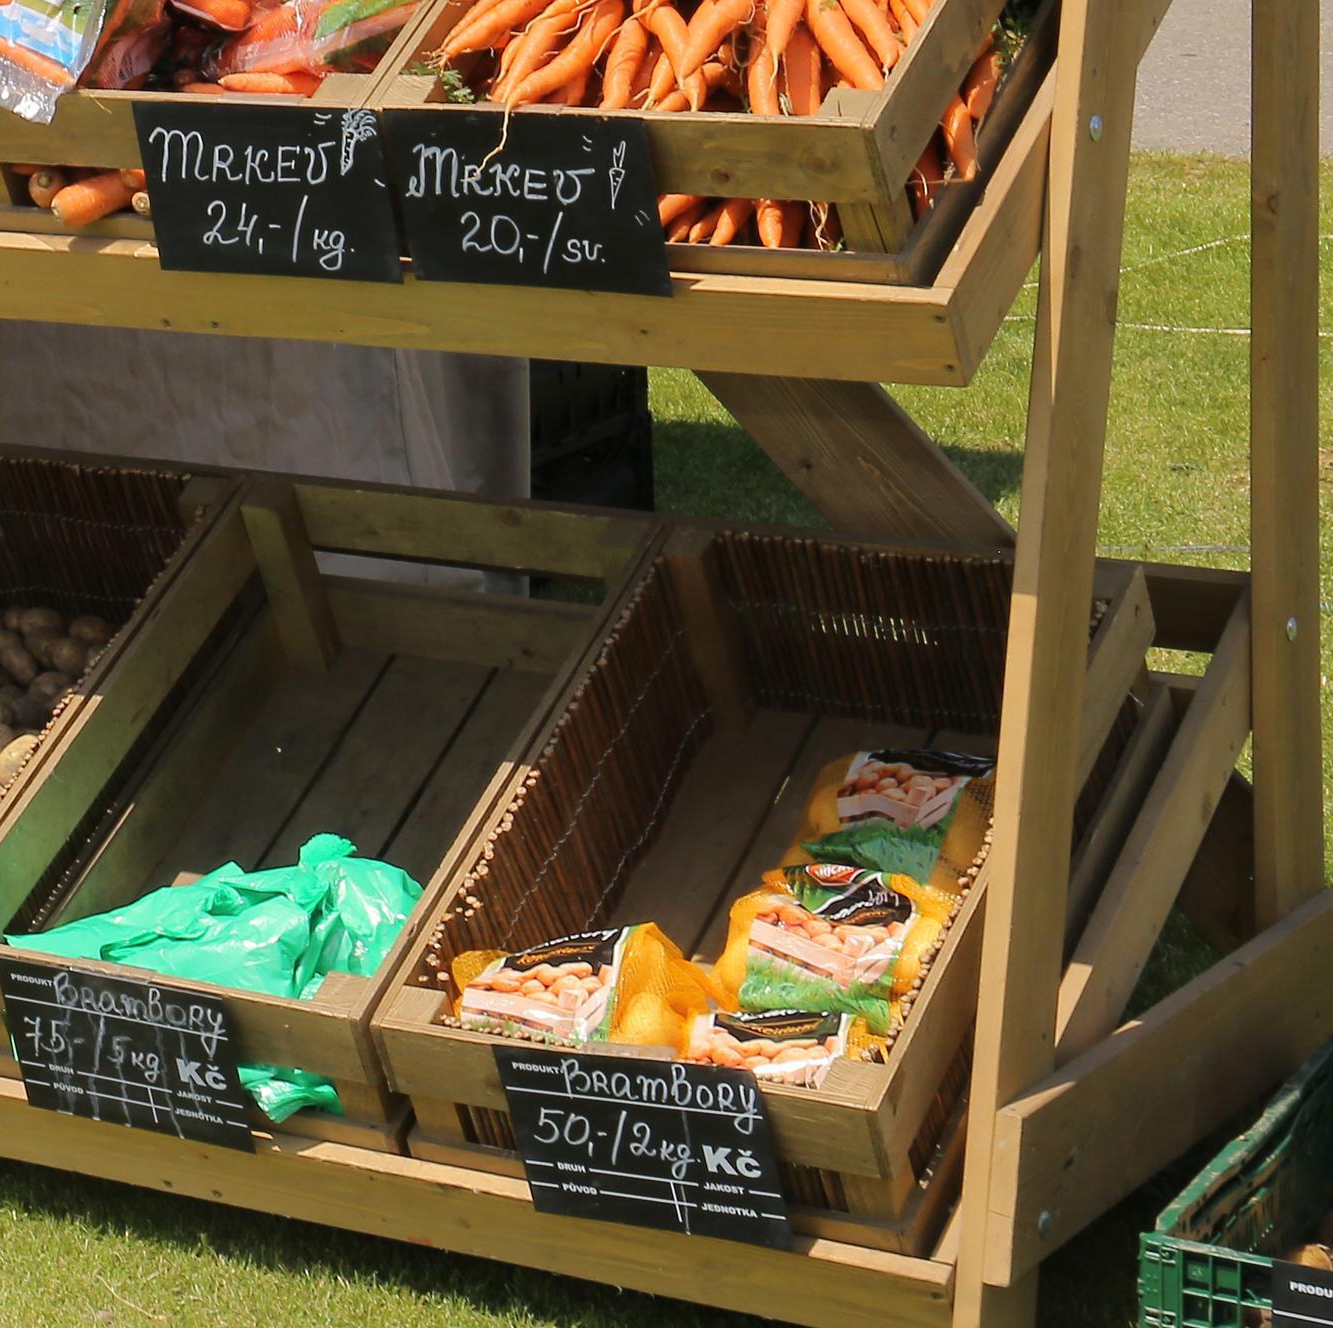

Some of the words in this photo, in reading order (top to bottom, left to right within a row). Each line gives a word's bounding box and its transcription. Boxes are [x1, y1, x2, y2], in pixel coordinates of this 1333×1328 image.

[10, 973, 54, 987] PRODUKT
[48, 1063, 74, 1075] DRUH
[176, 1089, 213, 1104] JAKOST
[175, 1057, 228, 1091] Kč
[511, 1061, 563, 1075] PRODUKT
[53, 1081, 84, 1095] PŮVOD
[174, 1107, 225, 1124] JEDNOTKA
[556, 1161, 587, 1174] DRUH
[703, 1182, 745, 1195] JAKOST
[702, 1144, 762, 1179] Kč
[562, 1181, 598, 1196] PŮVOD
[700, 1202, 758, 1218] JEDNOTKA
